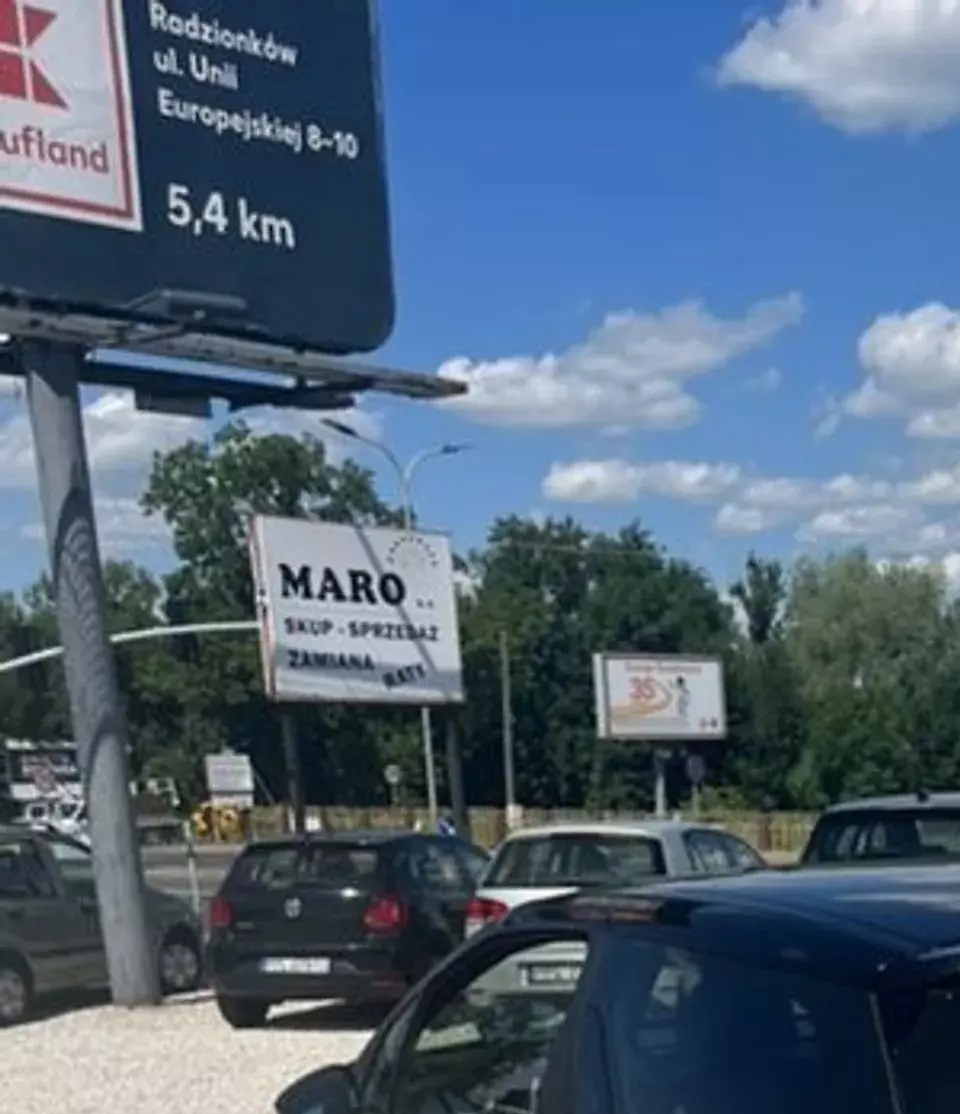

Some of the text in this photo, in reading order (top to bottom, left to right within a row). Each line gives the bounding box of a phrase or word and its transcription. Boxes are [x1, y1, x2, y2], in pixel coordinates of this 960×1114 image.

[150, 1, 298, 66] Radzionków
[153, 48, 238, 90] ul. Unii
[158, 87, 359, 159] Europejskiej 8-10
[167, 183, 295, 248] 5,4 km
[278, 562, 406, 606] MARO
[284, 617, 333, 637] SKUP
[288, 649, 375, 670] ZAMIANA
[382, 664, 426, 690] RATY
